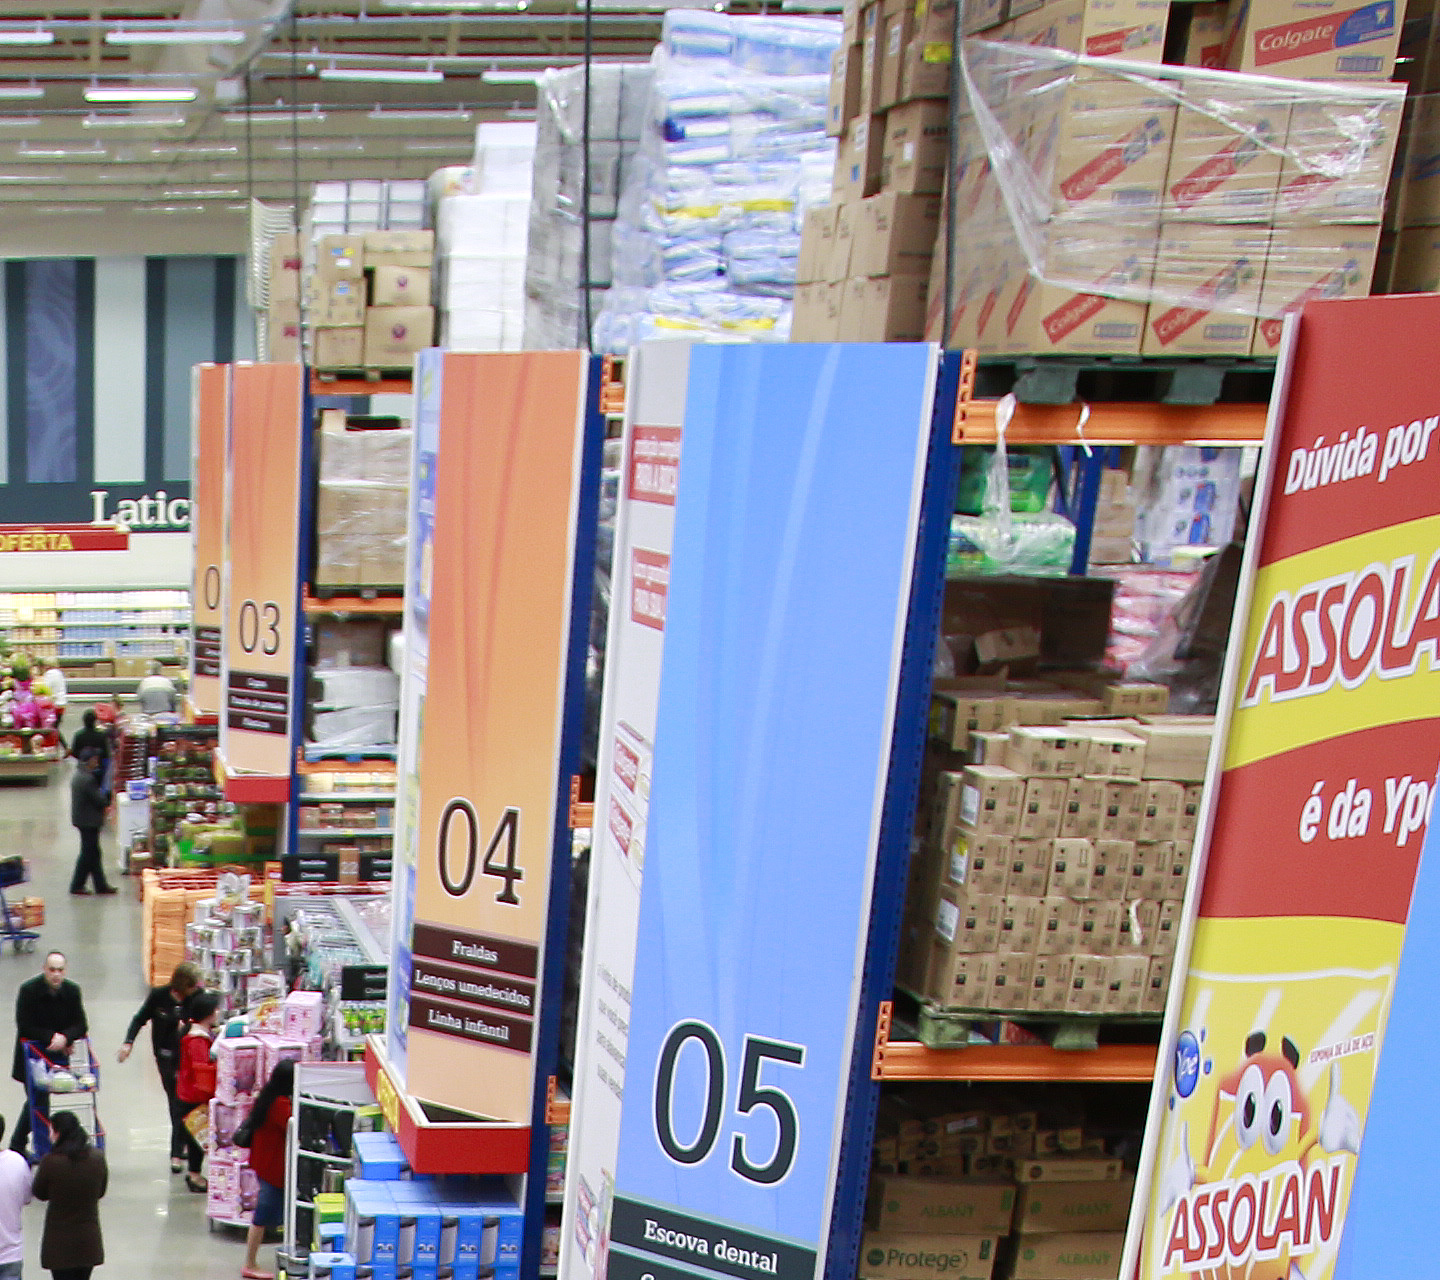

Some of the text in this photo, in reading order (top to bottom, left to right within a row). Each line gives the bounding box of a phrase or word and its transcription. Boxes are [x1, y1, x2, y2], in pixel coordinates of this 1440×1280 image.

[1259, 25, 1334, 53] Colgate
[1284, 423, 1378, 496] Dúvida
[1378, 412, 1438, 483] por
[90, 490, 194, 527] Latic
[239, 600, 281, 656] 03
[1299, 779, 1326, 843] é
[1327, 776, 1372, 841] da
[435, 795, 526, 909] 04
[451, 939, 499, 963] Fraldas
[414, 968, 531, 1007] Lenços umedecidos
[427, 1008, 510, 1041] Linha infantil
[651, 1017, 807, 1188] 05
[922, 1204, 975, 1218] ALBANY
[1061, 1202, 1112, 1216] ALBANY
[1160, 1158, 1346, 1272] ASSOLAN
[642, 1217, 779, 1275] Escova dental
[887, 1247, 960, 1271] Protege
[1056, 1253, 1110, 1266] ALBANY
